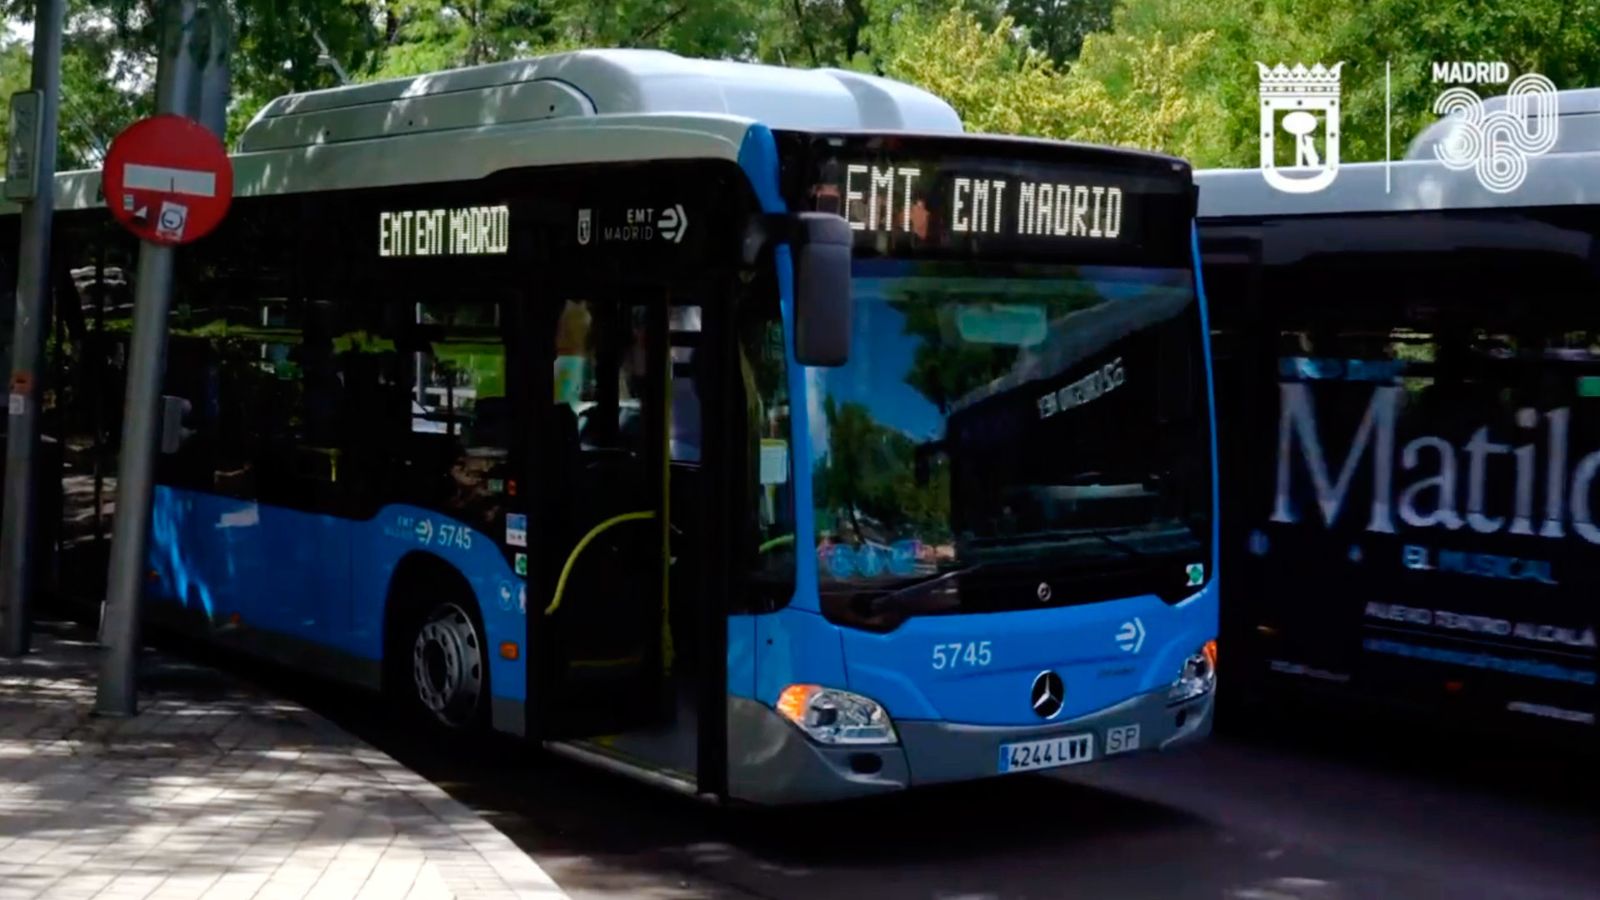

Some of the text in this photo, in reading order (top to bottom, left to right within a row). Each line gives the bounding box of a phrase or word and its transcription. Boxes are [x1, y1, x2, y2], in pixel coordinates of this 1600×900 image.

[845, 164, 1123, 239] EMT EMT MADRID
[626, 208, 655, 223] EMT
[380, 205, 509, 256] EMT EMT MADRID
[603, 226, 654, 241] MADRID
[438, 524, 472, 549] 5745
[932, 640, 992, 670] 5745
[1109, 727, 1137, 751] SP
[1010, 744, 1053, 768] 4244
